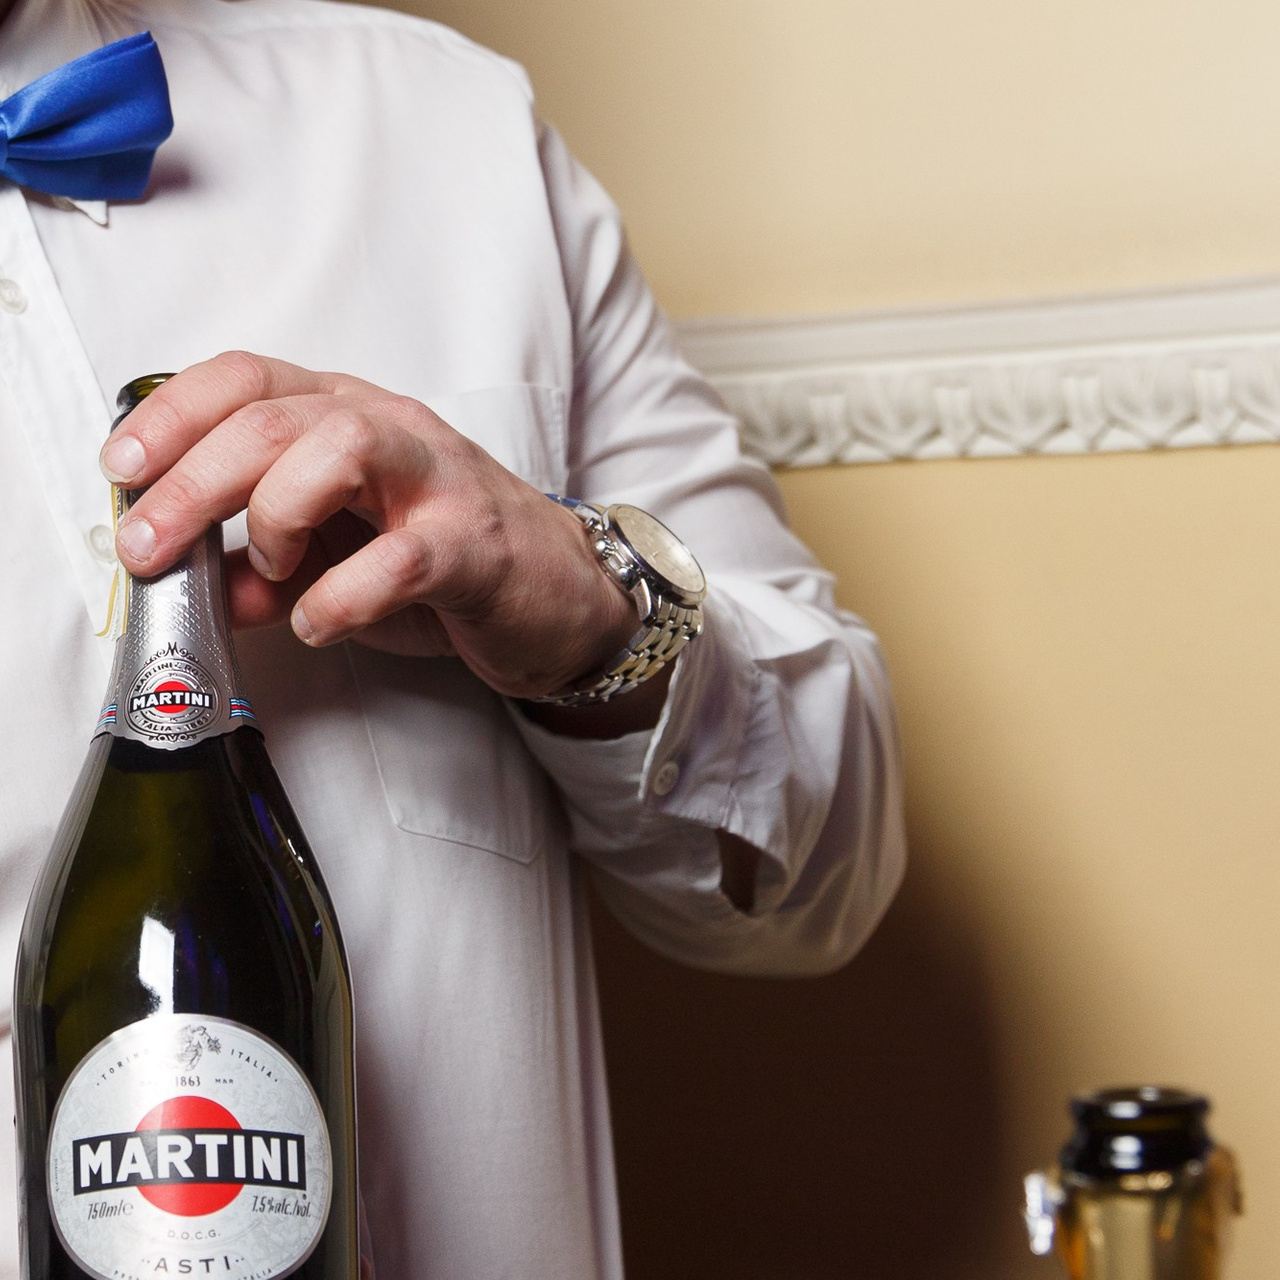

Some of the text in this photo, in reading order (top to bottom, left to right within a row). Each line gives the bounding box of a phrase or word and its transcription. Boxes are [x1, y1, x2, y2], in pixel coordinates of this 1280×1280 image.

[134, 662, 173, 693] MARTINI
[132, 691, 210, 711] MARTINI
[137, 717, 173, 732] ITALIA
[101, 1048, 273, 1081] TORINO ITALIA
[174, 1076, 201, 1087] 1863
[79, 1134, 300, 1190] MARTINI
[153, 1255, 231, 1274] ASTI
